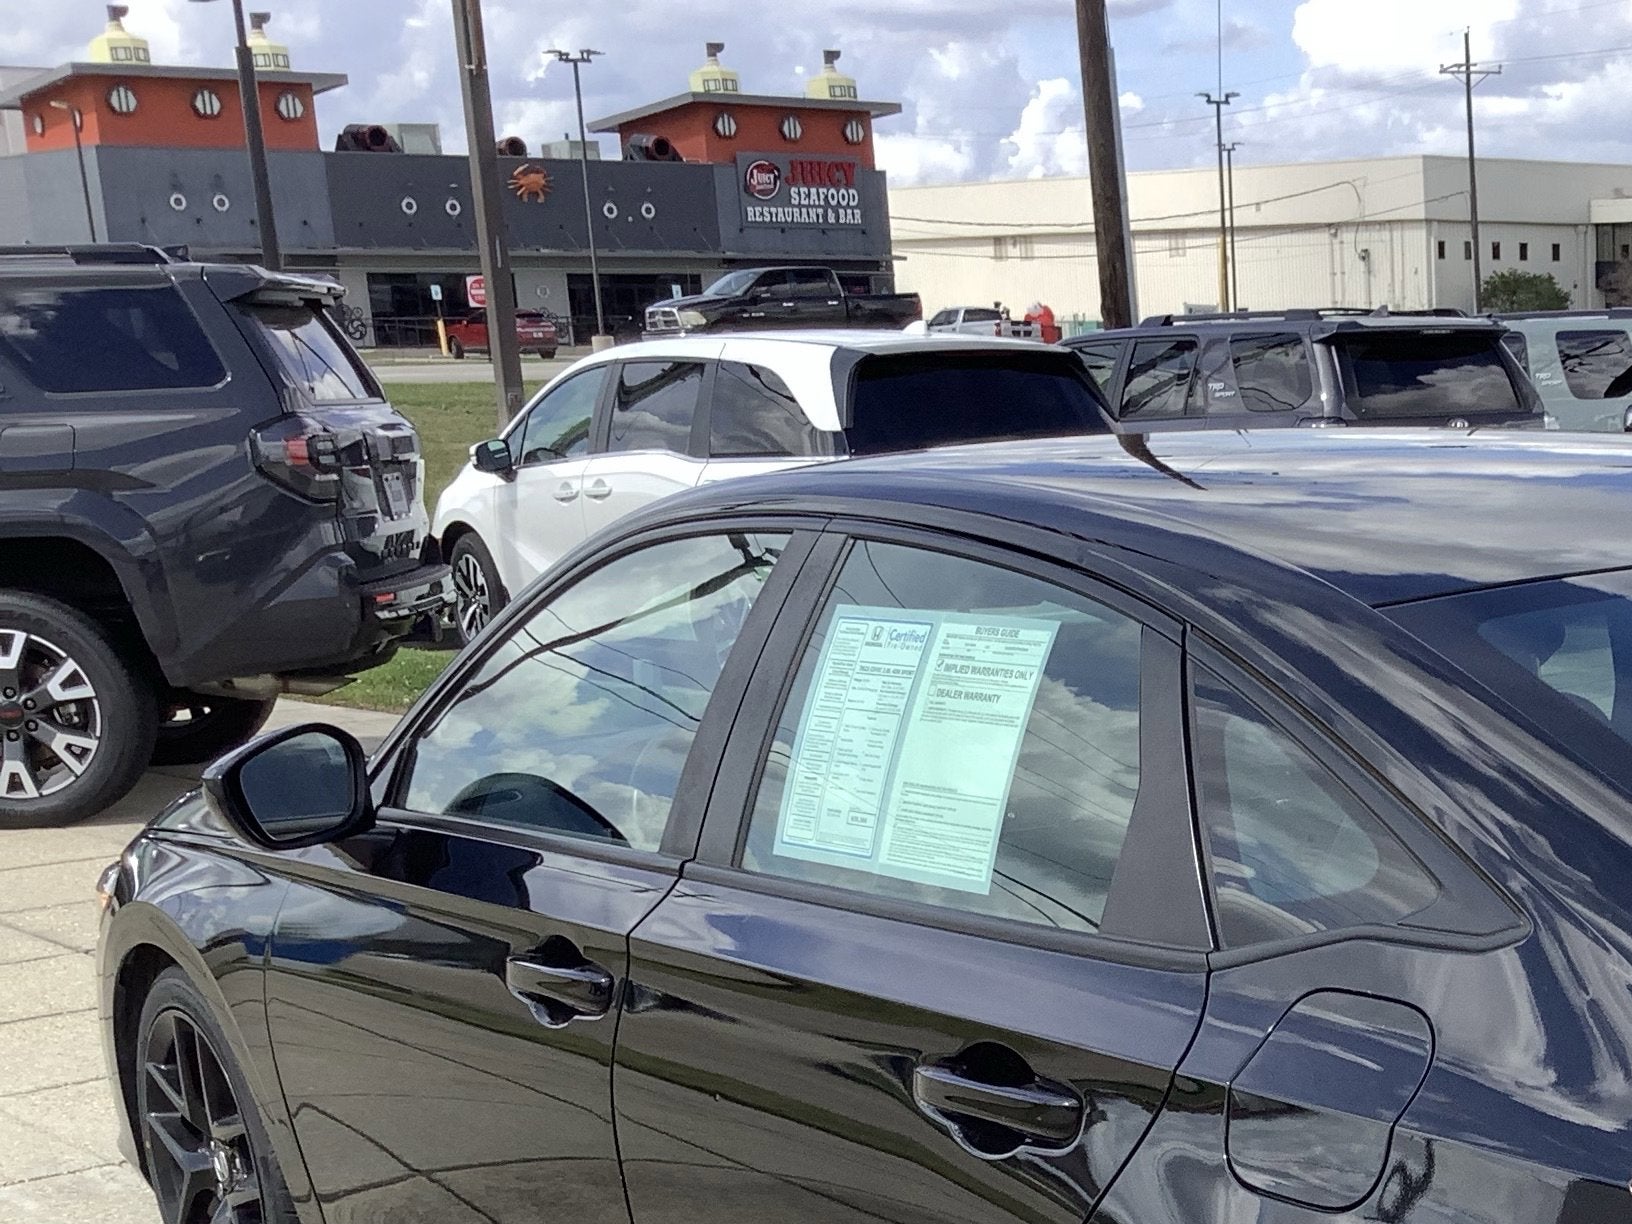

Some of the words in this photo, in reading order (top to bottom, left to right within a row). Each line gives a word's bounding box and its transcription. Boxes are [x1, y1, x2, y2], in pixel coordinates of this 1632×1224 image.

[784, 159, 856, 187] JUICY
[790, 186, 859, 207] SEAFOOD
[746, 206, 824, 223] RESTAURANT
[827, 208, 836, 223] &
[838, 208, 862, 225] BAR
[1207, 382, 1225, 391] TRD
[889, 628, 926, 643] Certified
[974, 626, 1000, 637] BUYERS
[1000, 628, 1020, 639] GUIDE
[943, 662, 970, 675] IMPLIED
[970, 664, 1014, 679] WARRANTIES
[1014, 669, 1035, 681] ONLY
[936, 688, 962, 700] DEALER
[963, 691, 1002, 704] WARRANTY
